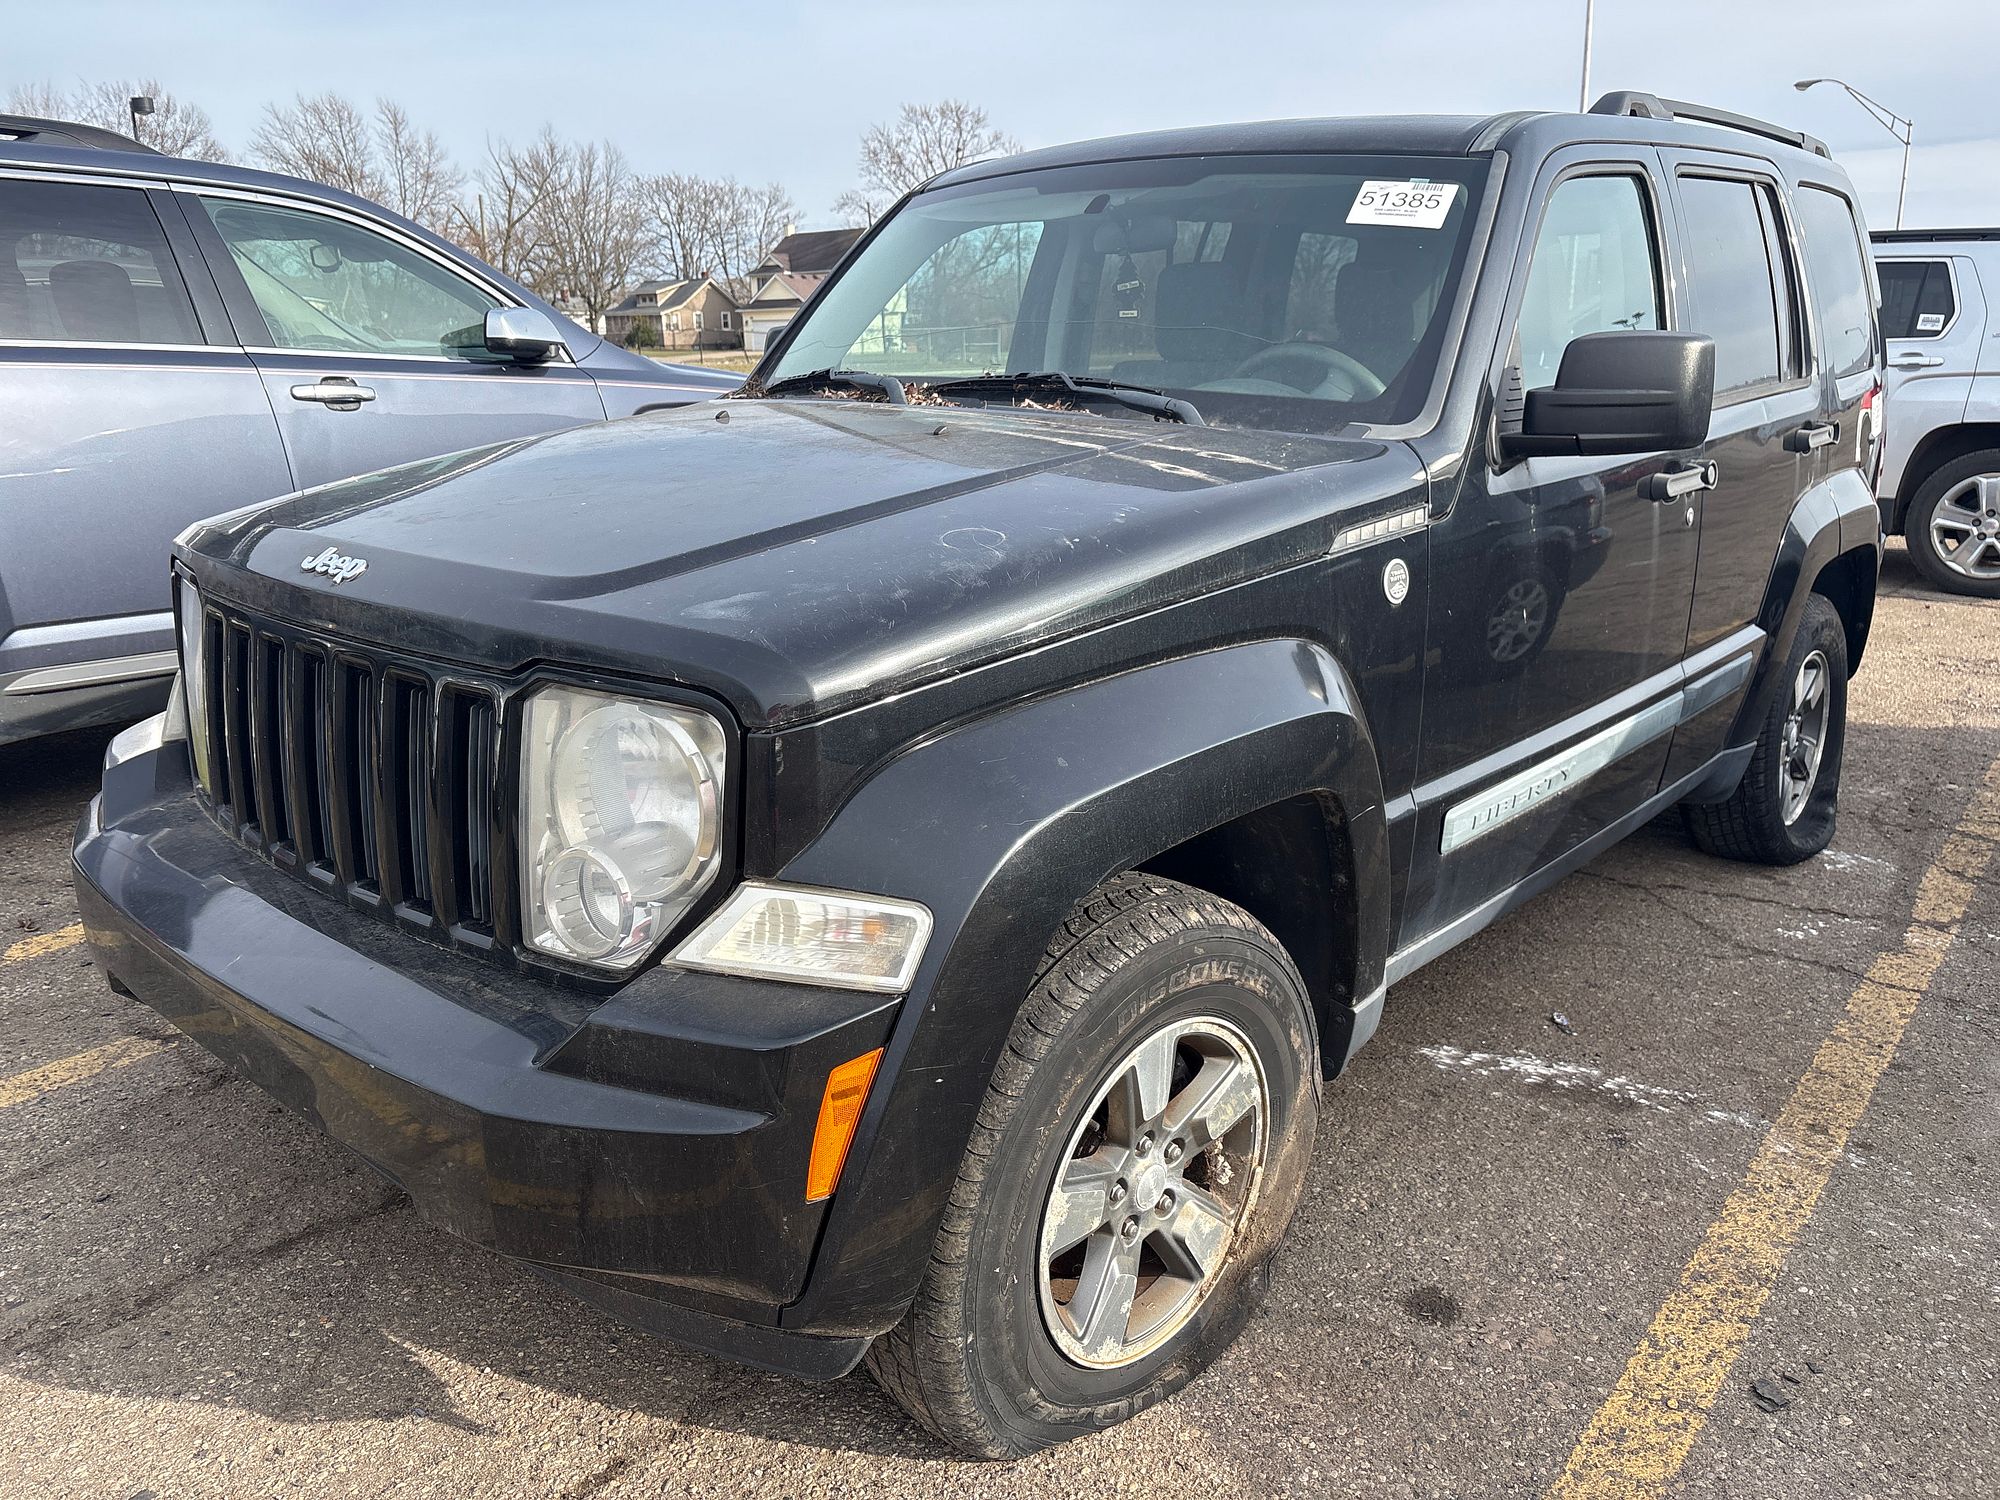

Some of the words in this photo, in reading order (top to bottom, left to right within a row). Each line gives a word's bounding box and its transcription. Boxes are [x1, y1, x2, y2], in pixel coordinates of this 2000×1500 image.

[1359, 191, 1443, 209] 51385
[301, 546, 368, 585] Jeep
[1471, 762, 1577, 830] LIBERTY
[1116, 959, 1286, 1036] DISCOVERER
